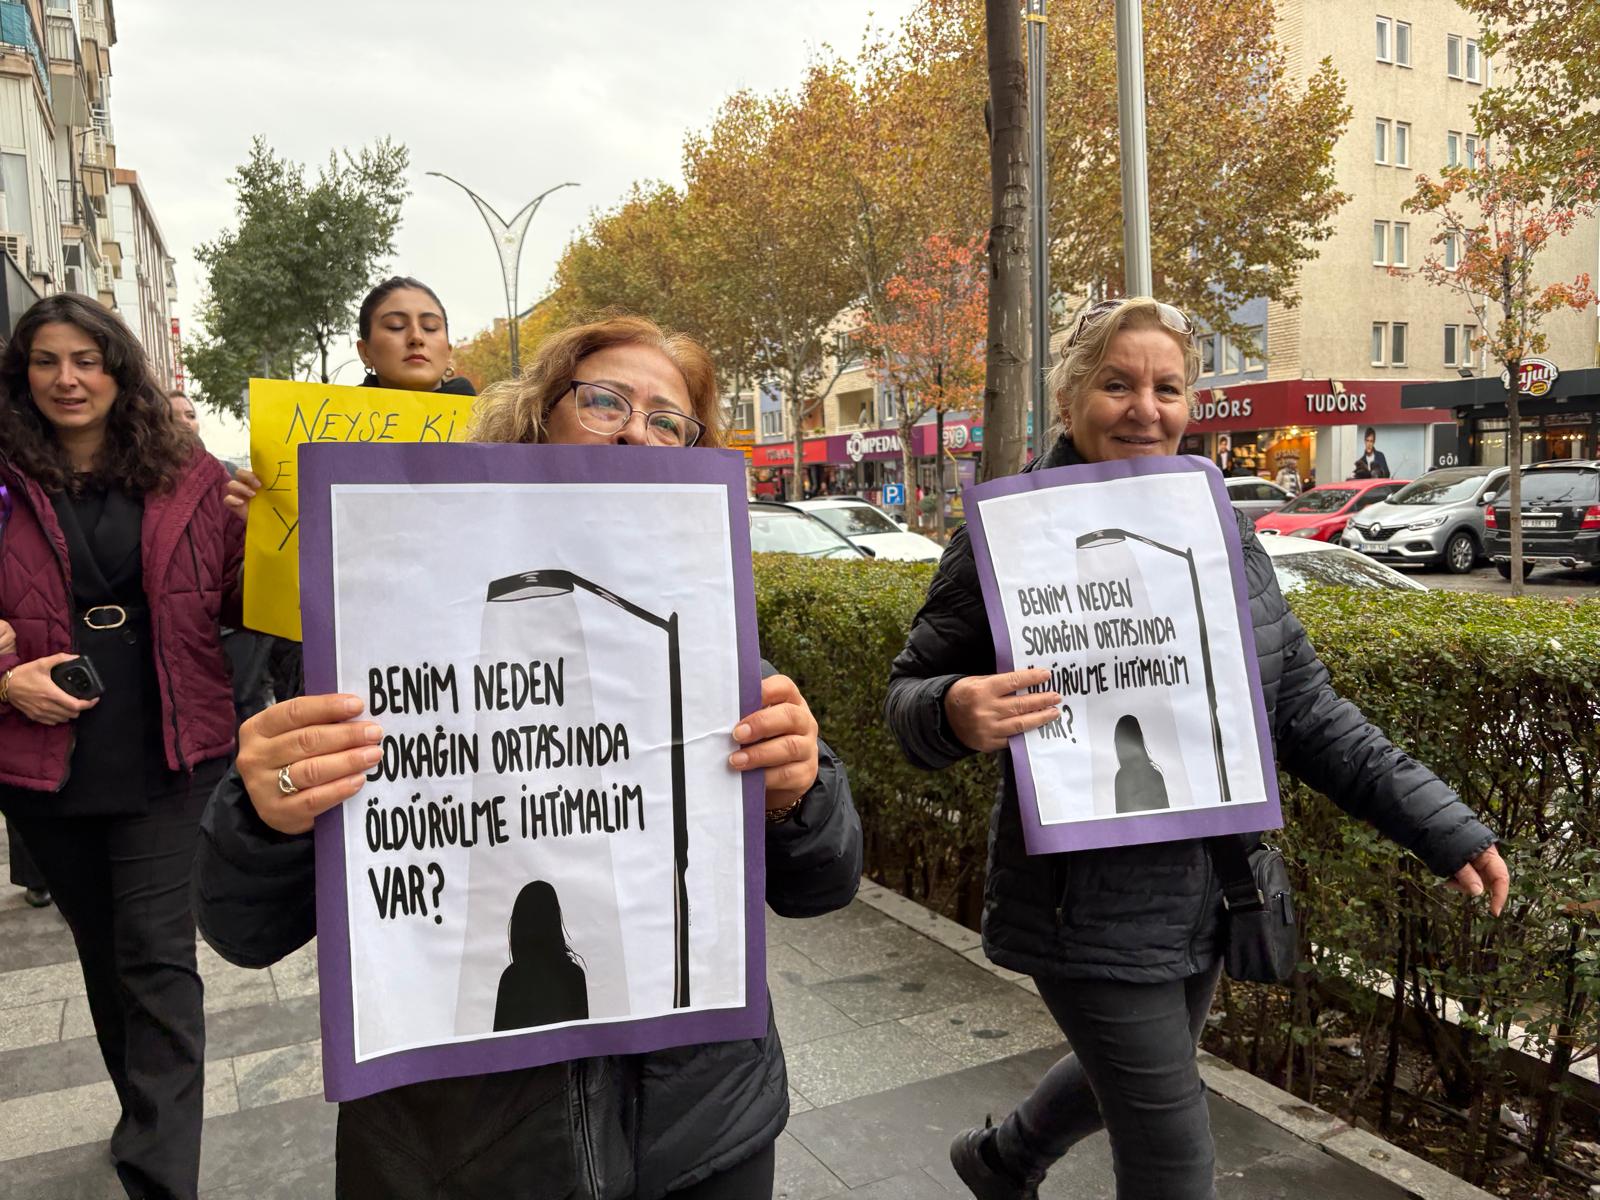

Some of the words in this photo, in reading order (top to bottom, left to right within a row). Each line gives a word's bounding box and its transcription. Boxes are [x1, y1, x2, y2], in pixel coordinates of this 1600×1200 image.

[286, 398, 399, 444] NEYSE
[1193, 398, 1251, 420] UDORS
[1306, 394, 1366, 413] TUDORS
[267, 461, 298, 491] E
[886, 486, 898, 503] P
[1018, 584, 1072, 616] BENİM
[1077, 578, 1133, 612] NEDEN
[1022, 620, 1089, 656] SOKAĞIN
[1094, 617, 1176, 649] ORTASINDA
[369, 661, 459, 716] BENİM
[474, 657, 564, 711] NEDEN
[1115, 655, 1190, 690] İHTİMALİM
[492, 723, 630, 774] ORTASINDA
[366, 792, 510, 852] ÖLDÜRÜLME
[521, 783, 645, 839] İHTİMALİM
[368, 862, 445, 924] VAR?
